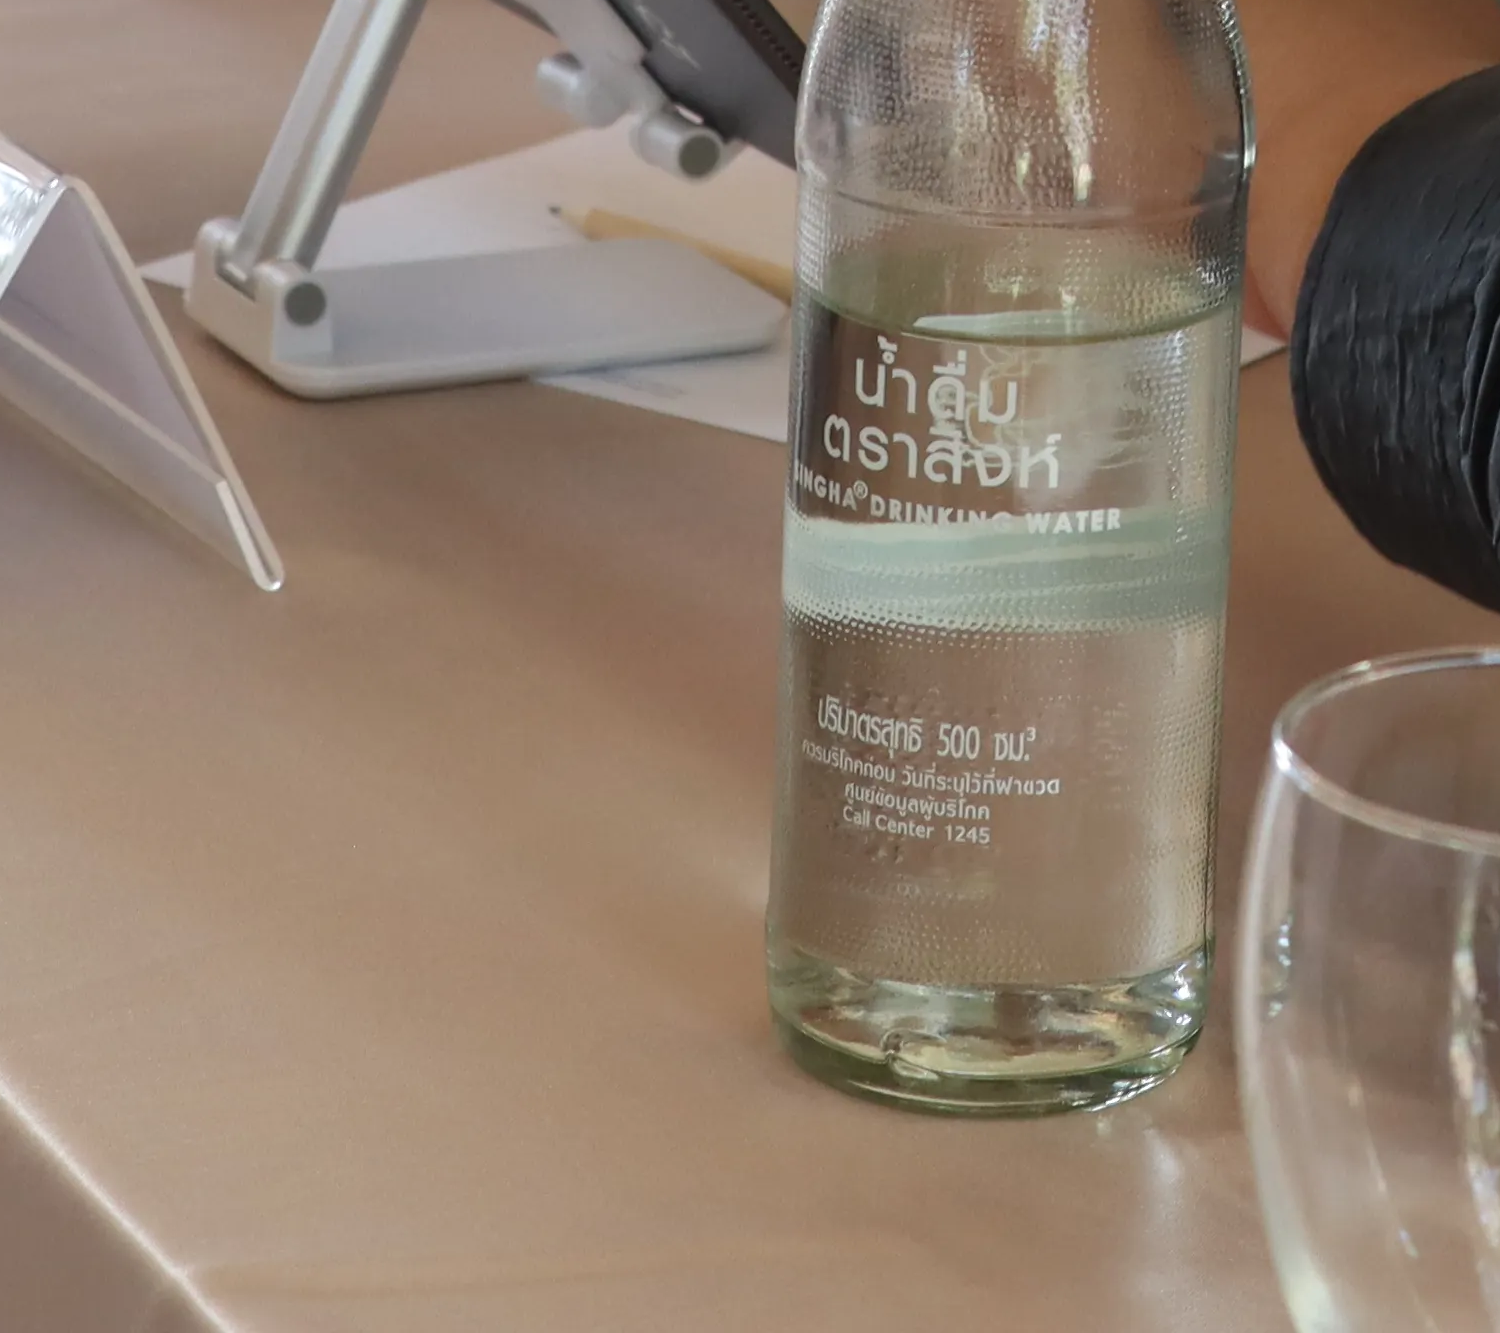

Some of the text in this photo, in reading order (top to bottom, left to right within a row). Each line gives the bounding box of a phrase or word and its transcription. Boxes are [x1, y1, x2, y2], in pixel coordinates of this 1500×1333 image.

[854, 335, 1018, 425] น้ำดื่ม
[823, 414, 1062, 489] ตราสิงห์
[870, 494, 1013, 532] DRINKING
[1025, 507, 1121, 535] WATER
[818, 694, 924, 759] ปริมาตรสุทธิ
[937, 723, 981, 760] 500
[843, 805, 991, 845] Call Center 1245
